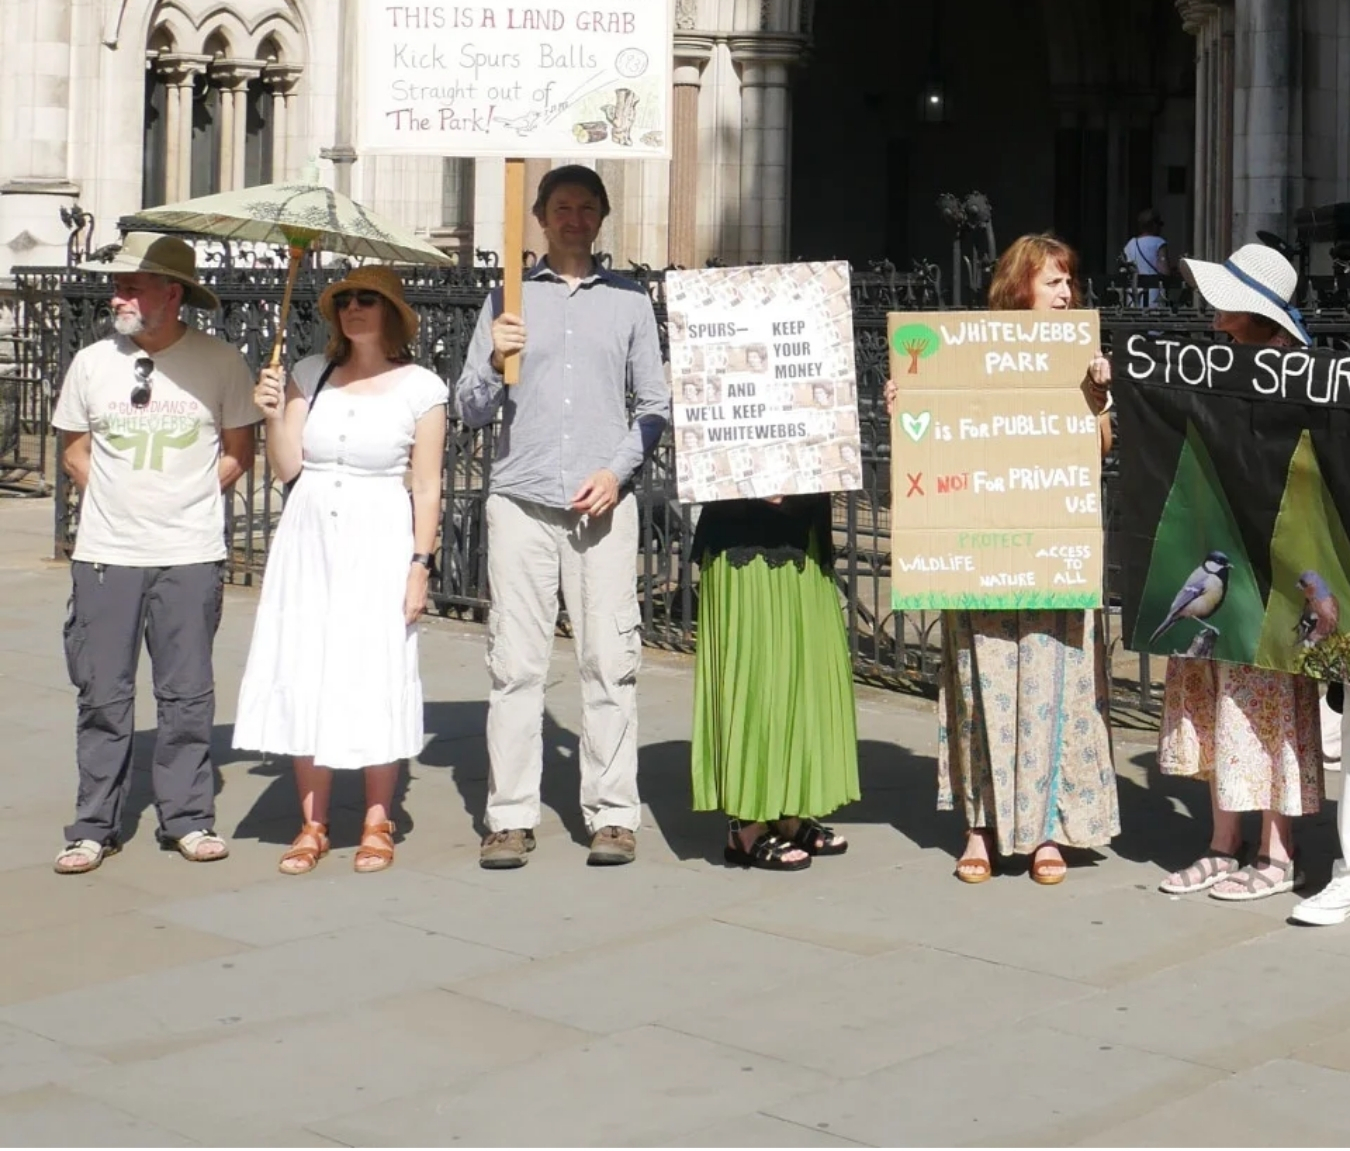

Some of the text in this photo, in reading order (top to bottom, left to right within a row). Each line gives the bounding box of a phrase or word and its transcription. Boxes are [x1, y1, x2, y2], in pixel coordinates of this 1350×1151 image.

[386, 6, 636, 34] THIS IS A LAND GRAB
[393, 43, 447, 69] Kick
[459, 43, 520, 80] Spurs
[538, 43, 597, 69] Balls
[391, 80, 556, 107] Straight out of
[386, 104, 496, 134] The Park!
[772, 320, 805, 336] KEEP
[773, 342, 811, 357] YOUR
[984, 352, 1049, 375] PARK
[1126, 334, 1235, 389] STOP
[775, 362, 823, 379] MONEY
[727, 383, 756, 398] AND
[685, 404, 766, 422] WE'LL KEEP
[937, 473, 970, 494] NOT
[957, 531, 1035, 548] PROTECT
[1035, 545, 1092, 558] ACCESS
[1062, 558, 1083, 571] TO
[979, 572, 1036, 587] NATURE
[1053, 570, 1087, 585] ALL
